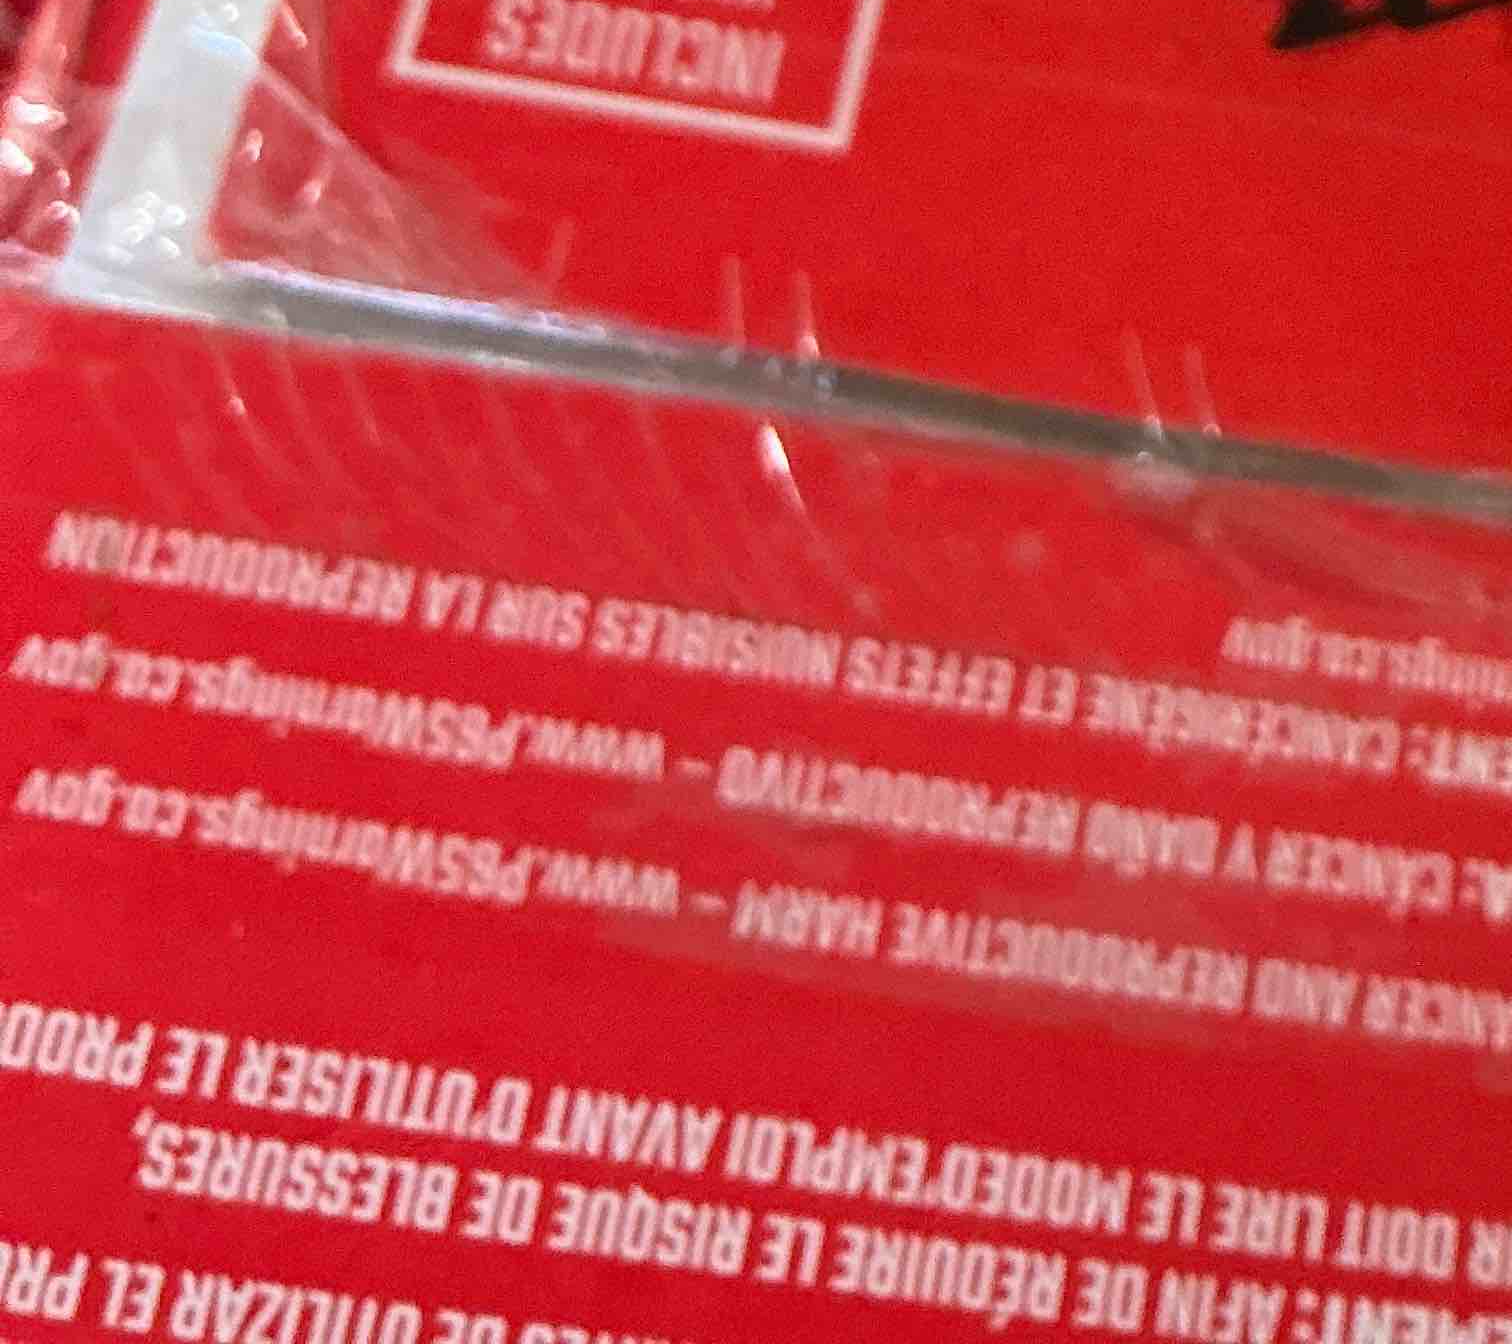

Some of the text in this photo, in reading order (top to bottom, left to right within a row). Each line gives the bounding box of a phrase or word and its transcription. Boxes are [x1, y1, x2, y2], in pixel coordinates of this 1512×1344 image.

[44, 509, 414, 626] REPRODUCTION
[417, 566, 487, 633] LA
[485, 578, 592, 653] SUR
[592, 595, 841, 692] NUISIBLES
[842, 634, 1016, 716] EFFETS
[1017, 663, 1083, 726] ET
[716, 744, 1082, 856] REPRODUCTIVO
[1223, 820, 1261, 884] Y
[1263, 826, 1457, 916] CÁNCER
[731, 879, 885, 959] HARM
[888, 901, 1250, 1011] REPRODUCTIVE
[1252, 954, 1360, 1032] AND
[0, 999, 154, 1090] PROD
[155, 1023, 231, 1100] LE
[231, 1034, 534, 1148] D'UTILISER
[531, 1083, 722, 1174] AVANT
[131, 1105, 459, 1234] BLESSURES,
[458, 1168, 545, 1246] DE
[1140, 1170, 1212, 1247] LE
[546, 1180, 752, 1278] RISQUE
[752, 1211, 828, 1289] LE
[1207, 1180, 1332, 1265] LIRE
[1334, 1200, 1460, 1282] DOIT
[100, 1254, 169, 1334] EL
[828, 1222, 1070, 1333] RÉDUIRE
[1070, 1255, 1151, 1338] DE
[1153, 1265, 1289, 1344] AFIN
